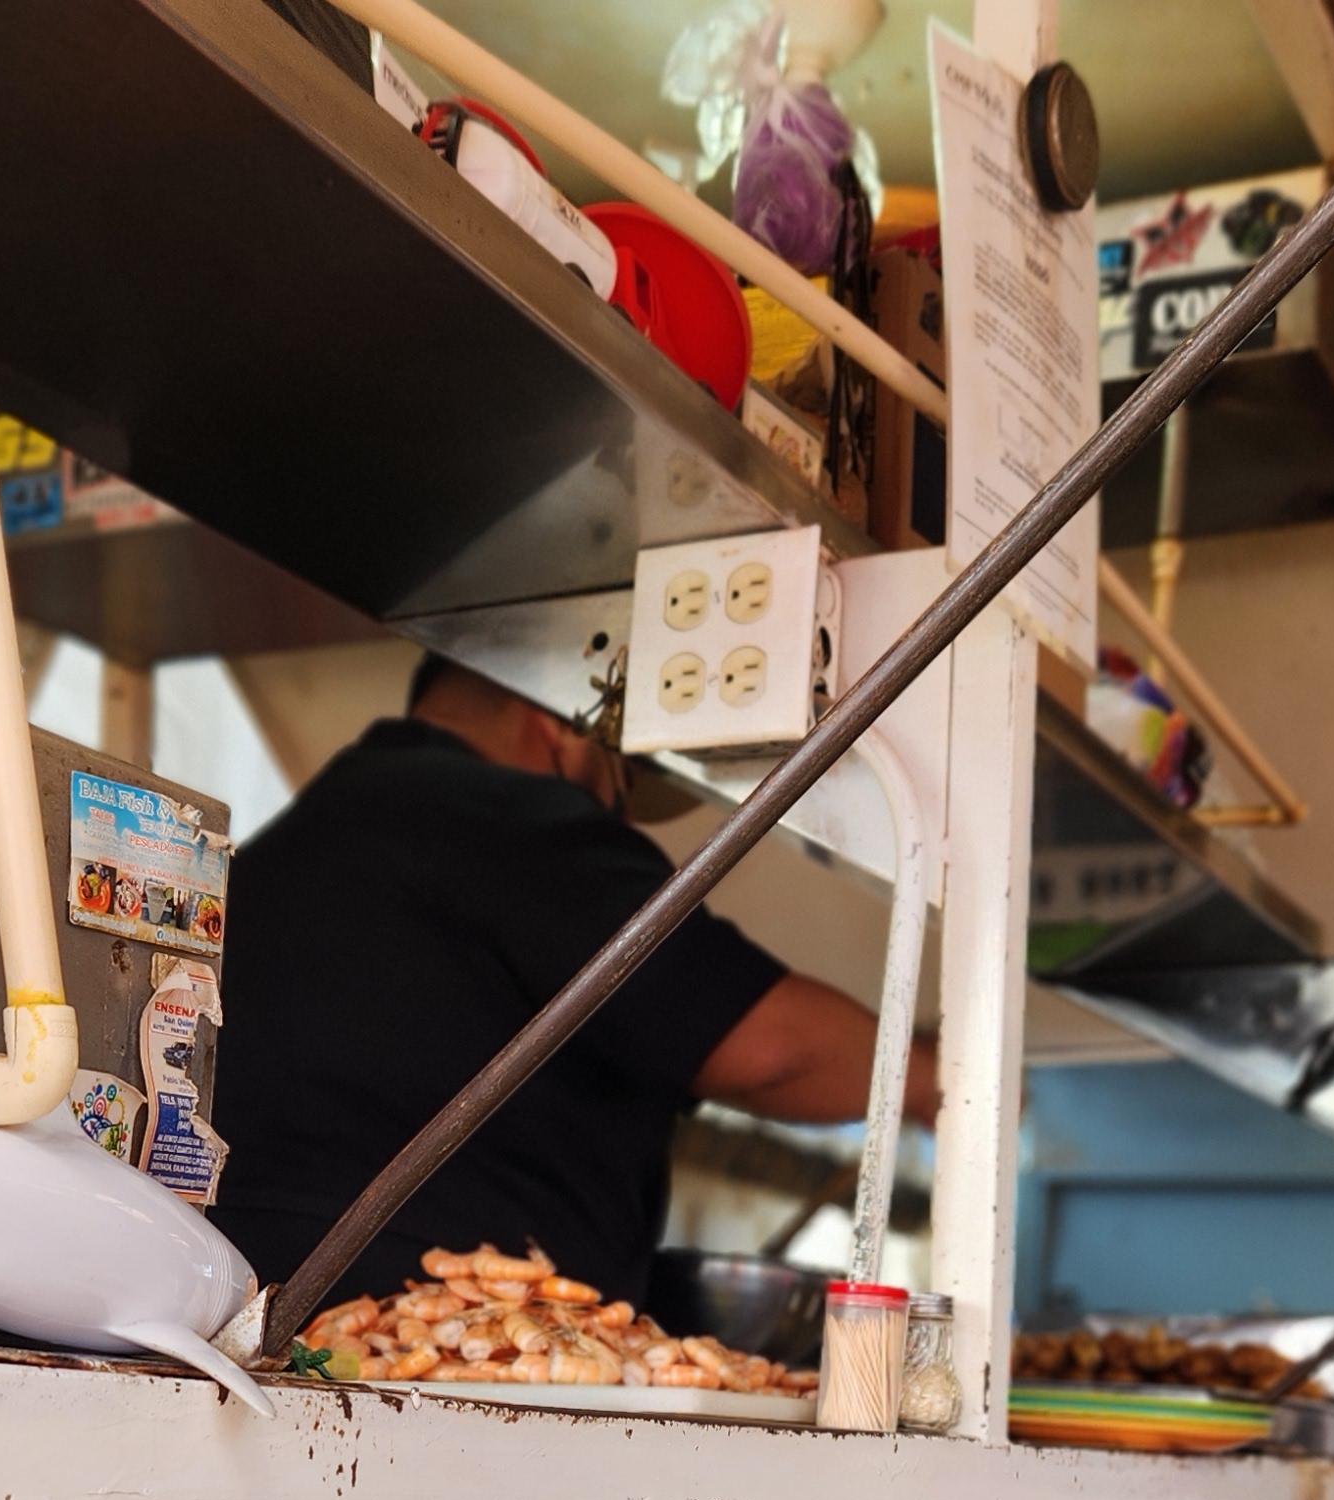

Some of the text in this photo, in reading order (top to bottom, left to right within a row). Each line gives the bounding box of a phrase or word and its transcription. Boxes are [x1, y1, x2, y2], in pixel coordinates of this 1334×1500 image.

[78, 778, 117, 807] BAJA
[118, 788, 154, 817] Fish
[129, 833, 174, 853] PESCADO
